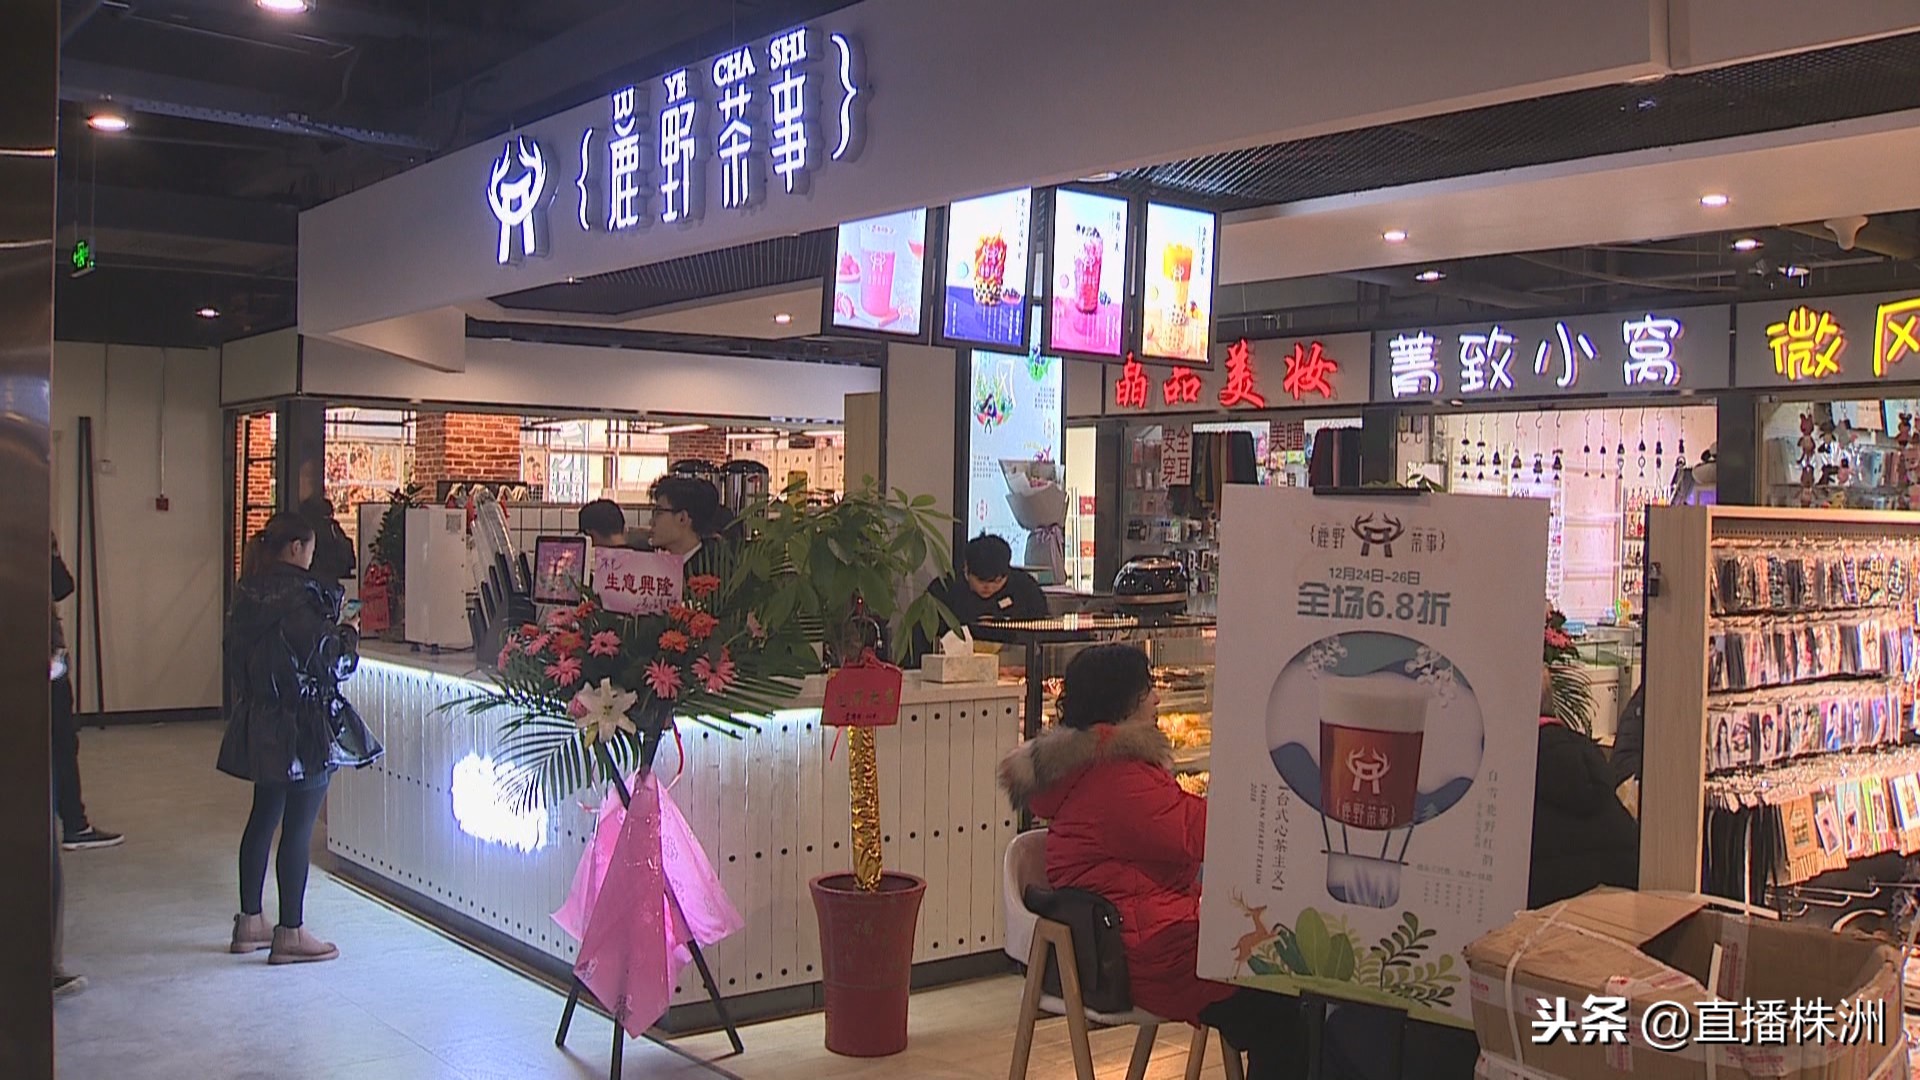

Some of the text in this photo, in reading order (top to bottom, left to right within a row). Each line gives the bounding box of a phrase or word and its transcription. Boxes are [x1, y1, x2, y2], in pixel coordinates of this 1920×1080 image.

[664, 69, 687, 104] YE
[713, 47, 756, 87] CHA
[769, 28, 807, 70] SHI
[1115, 337, 1338, 409] 晶品美妆
[1390, 314, 1680, 398] 菁致小窝
[1163, 425, 1189, 453] 安全
[1270, 422, 1305, 451] 美瞳
[1162, 456, 1190, 482] 穿耳
[1329, 566, 1420, 585] 12月24日-26日
[1297, 582, 1451, 627] 全场6.8折
